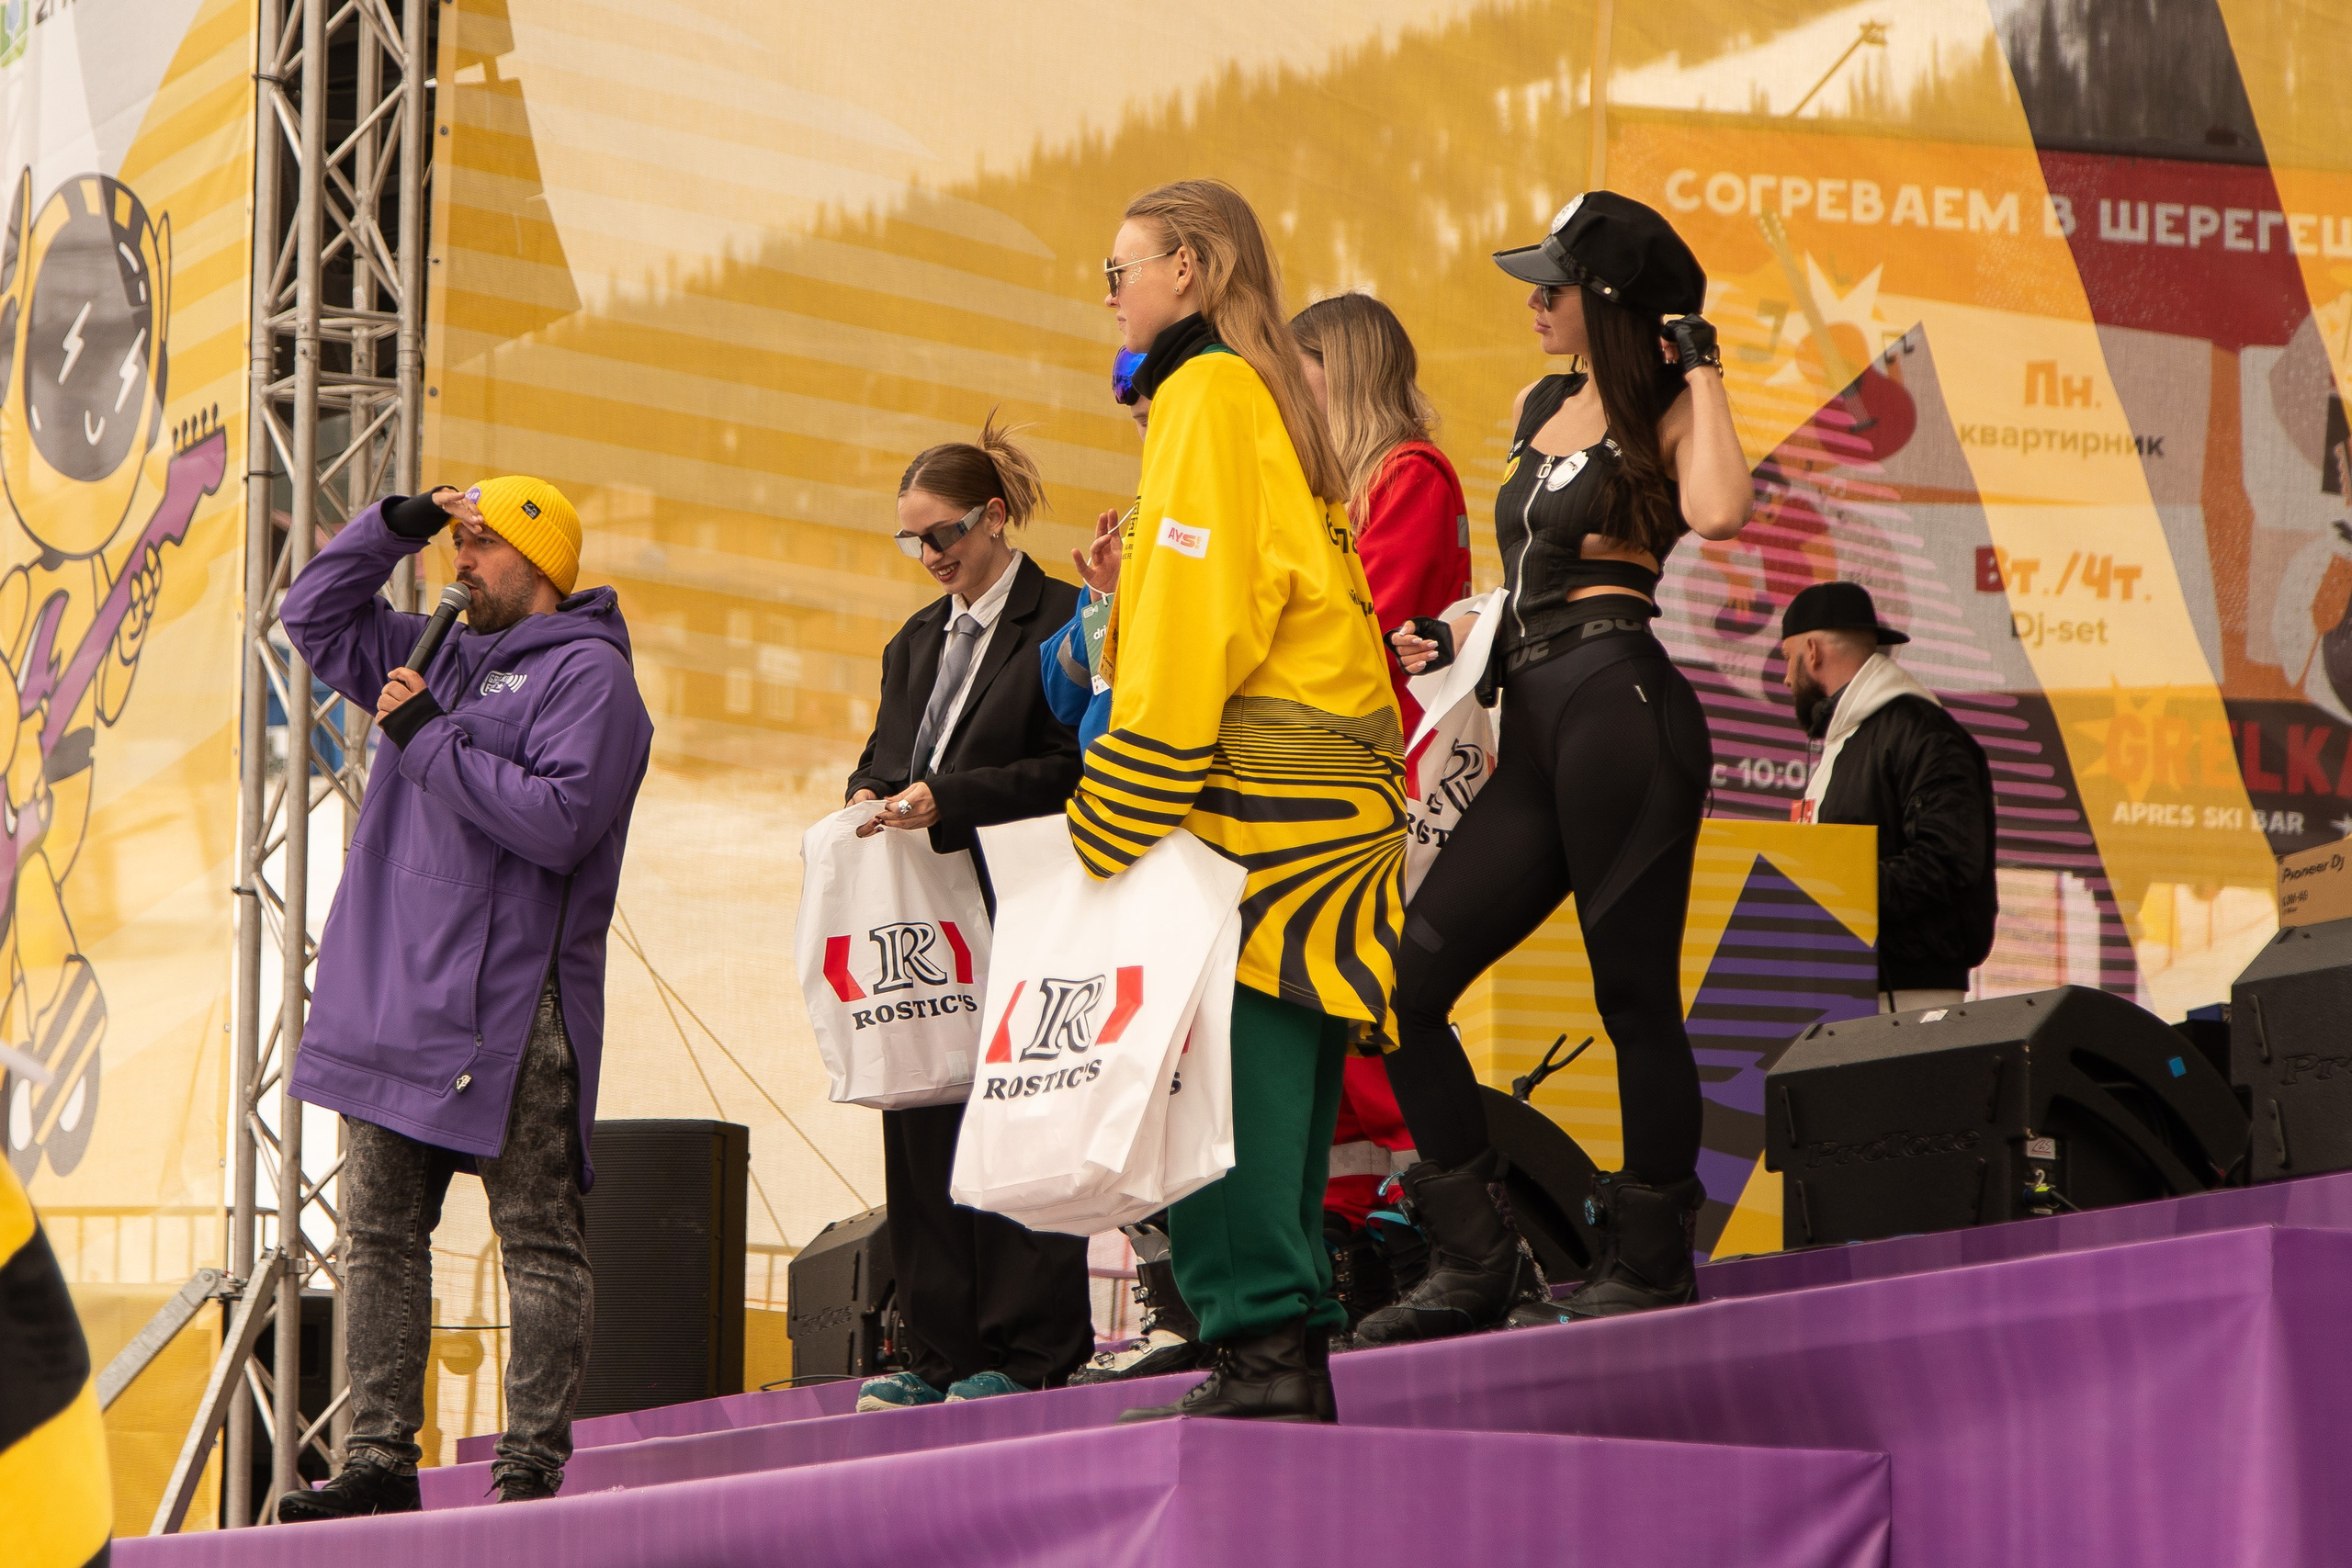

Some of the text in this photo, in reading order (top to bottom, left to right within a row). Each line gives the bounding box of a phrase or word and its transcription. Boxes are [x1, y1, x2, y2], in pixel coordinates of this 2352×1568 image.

[1665, 168, 2021, 236] СОГРЕВАЕМ
[2042, 190, 2077, 240] В
[2023, 358, 2103, 410] Пн.
[1959, 423, 2165, 461] квартирник
[1168, 526, 1203, 550] AYS!
[2011, 610, 2109, 649] Dj-set
[2113, 800, 2306, 837] APRES SKI BAR
[2281, 861, 2330, 885] Pioneer
[852, 994, 978, 1030] ROSTIC'S
[983, 1058, 1102, 1100] ROSTIC'S
[1805, 1128, 1983, 1169] ProTone
